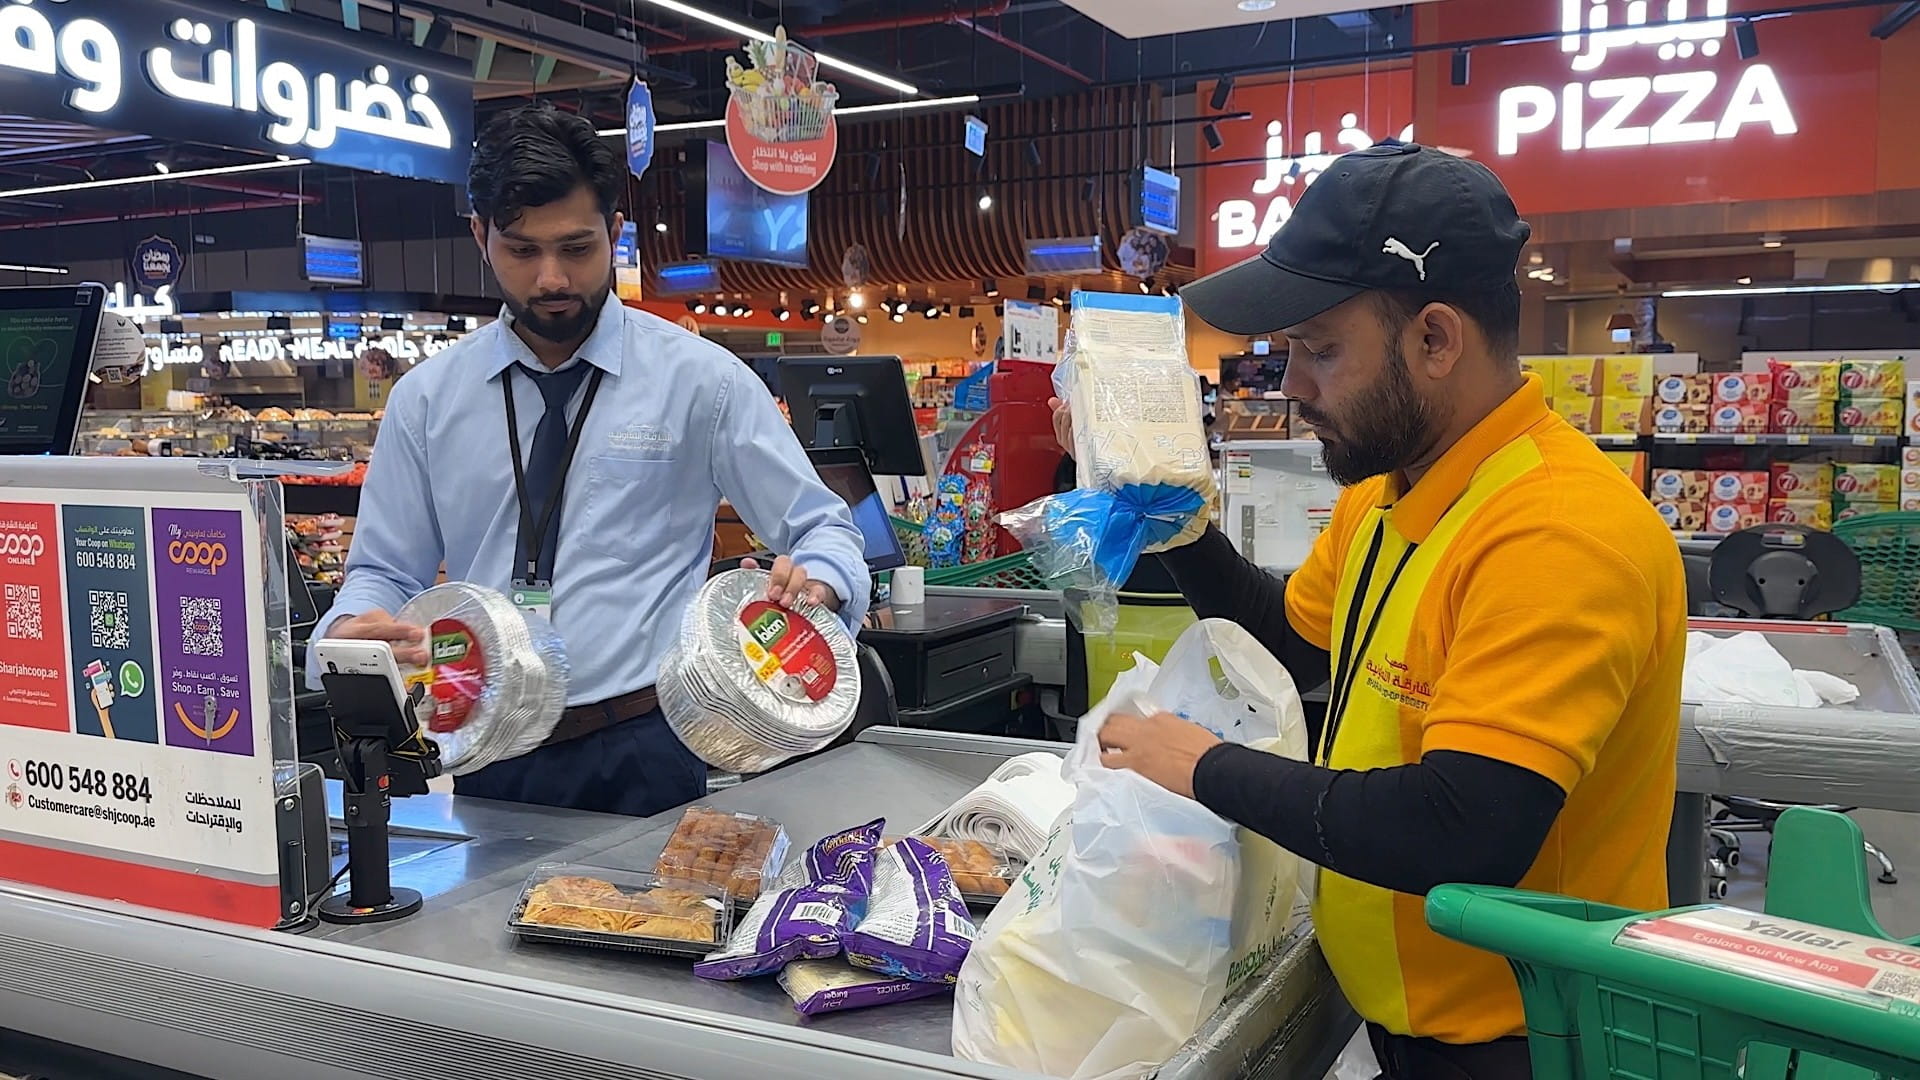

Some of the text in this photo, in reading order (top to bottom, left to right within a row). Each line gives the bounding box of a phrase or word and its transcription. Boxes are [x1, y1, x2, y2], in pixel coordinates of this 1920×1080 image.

[147, 18, 452, 149] خضروات
[1497, 63, 1799, 157] PIZZA
[752, 159, 769, 173] Shop
[769, 160, 785, 172] with
[794, 164, 817, 177] waiting
[1217, 195, 1292, 248] BA
[98, 526, 110, 536] على
[168, 523, 182, 540] My
[75, 537, 87, 547] Your
[87, 538, 101, 549] Coop
[101, 540, 108, 548] on
[7, 557, 32, 565] ONLINE
[76, 551, 136, 570] 600 548 884
[172, 681, 240, 698] Shop Earn Save
[25, 760, 153, 804] 600 548 884
[185, 791, 241, 811] للملاحظات
[28, 794, 156, 829] Customercare@shjcoop.ae
[1742, 919, 1852, 950] Yalla!
[1692, 932, 1841, 974] Explore Our New App
[824, 990, 849, 1001] Burger
[876, 983, 911, 995] 20 SLICES
